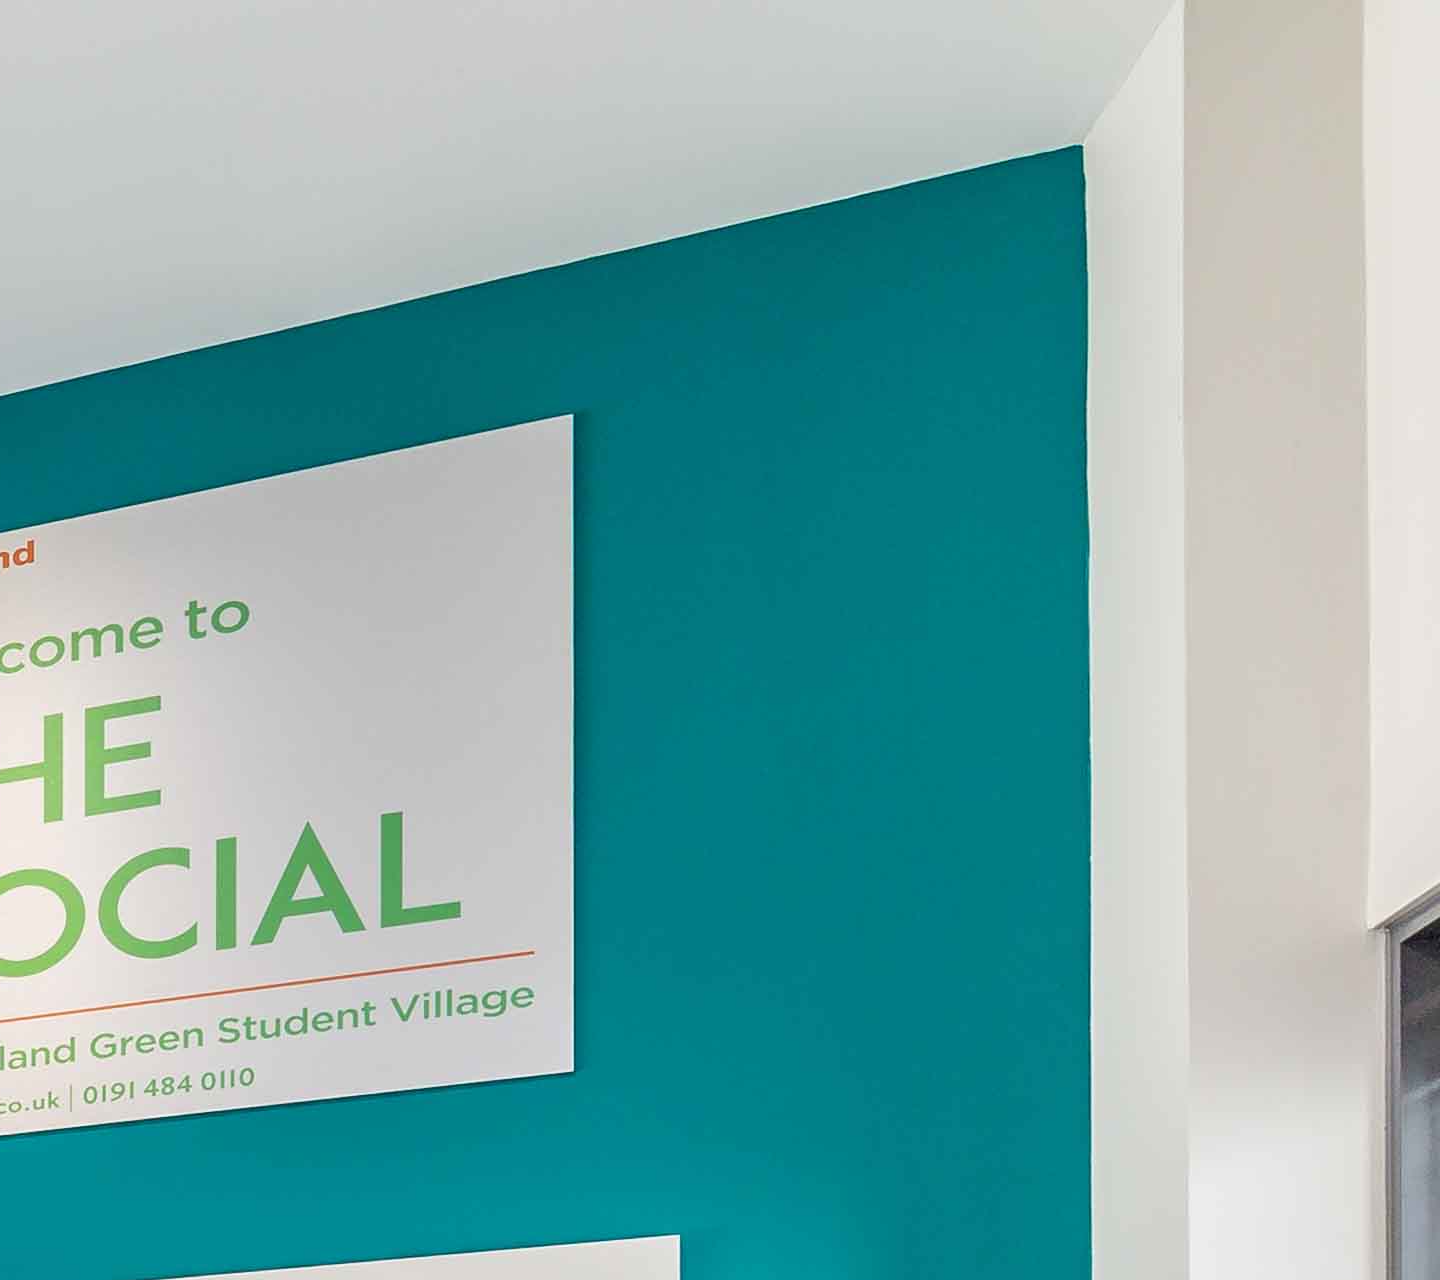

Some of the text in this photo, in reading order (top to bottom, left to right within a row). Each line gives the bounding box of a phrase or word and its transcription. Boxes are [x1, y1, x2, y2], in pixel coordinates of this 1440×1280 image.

[184, 599, 250, 639] to
[89, 1026, 205, 1060] Green
[218, 999, 377, 1044] Student
[391, 984, 536, 1027] Village
[83, 1080, 135, 1105] 0191
[144, 1074, 191, 1097] 484
[201, 1067, 255, 1091] 0110
